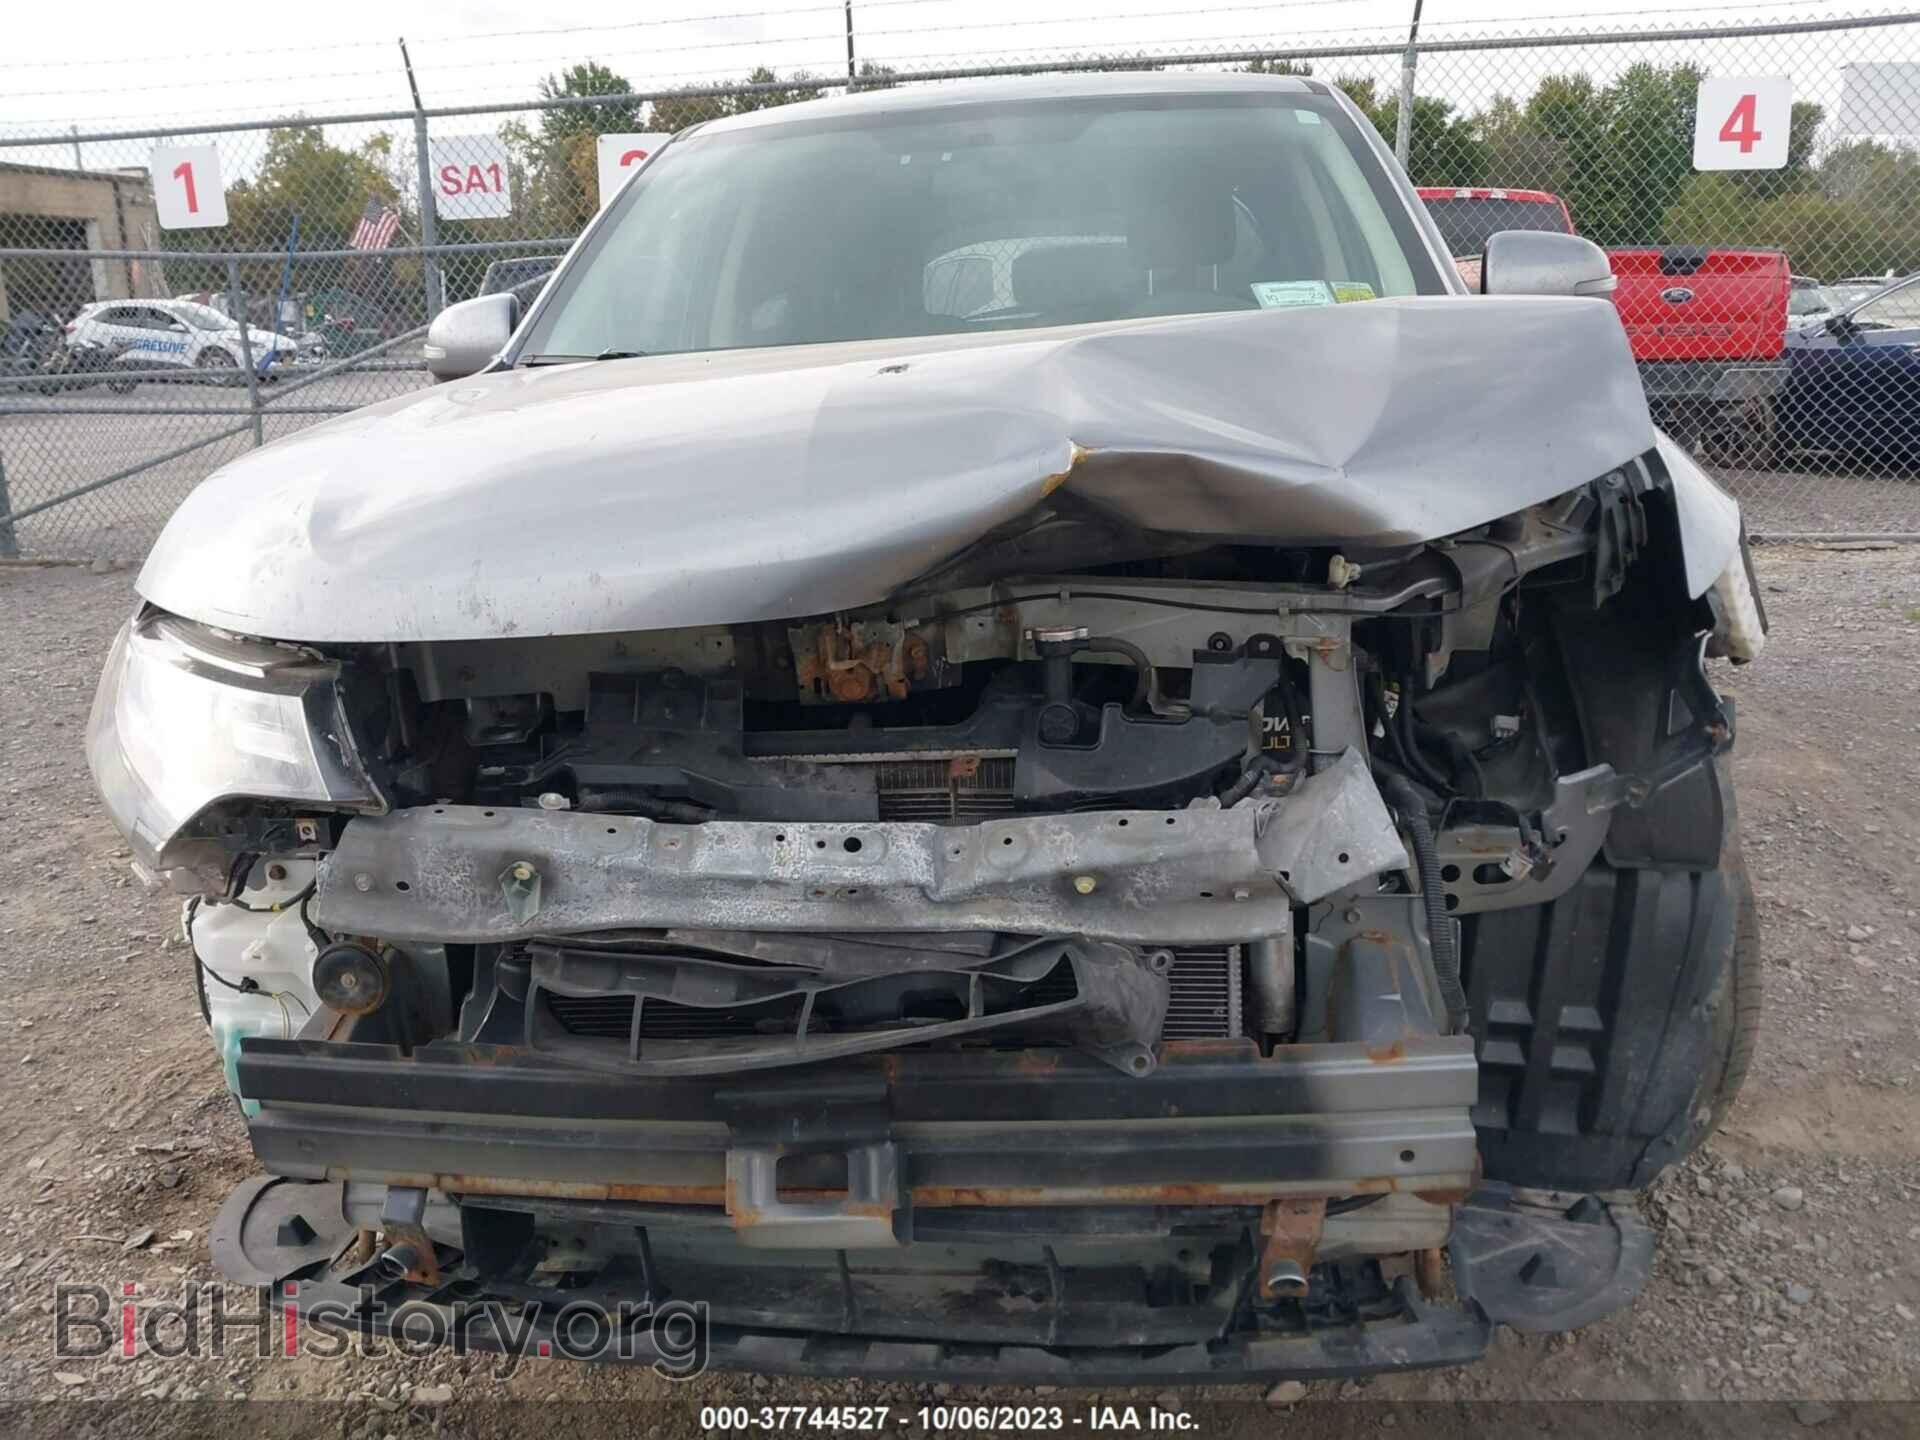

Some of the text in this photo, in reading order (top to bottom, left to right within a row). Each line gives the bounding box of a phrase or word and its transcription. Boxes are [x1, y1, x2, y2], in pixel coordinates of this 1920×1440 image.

[1719, 94, 1762, 153] 4
[173, 161, 199, 214] 1
[440, 162, 502, 196] SA1
